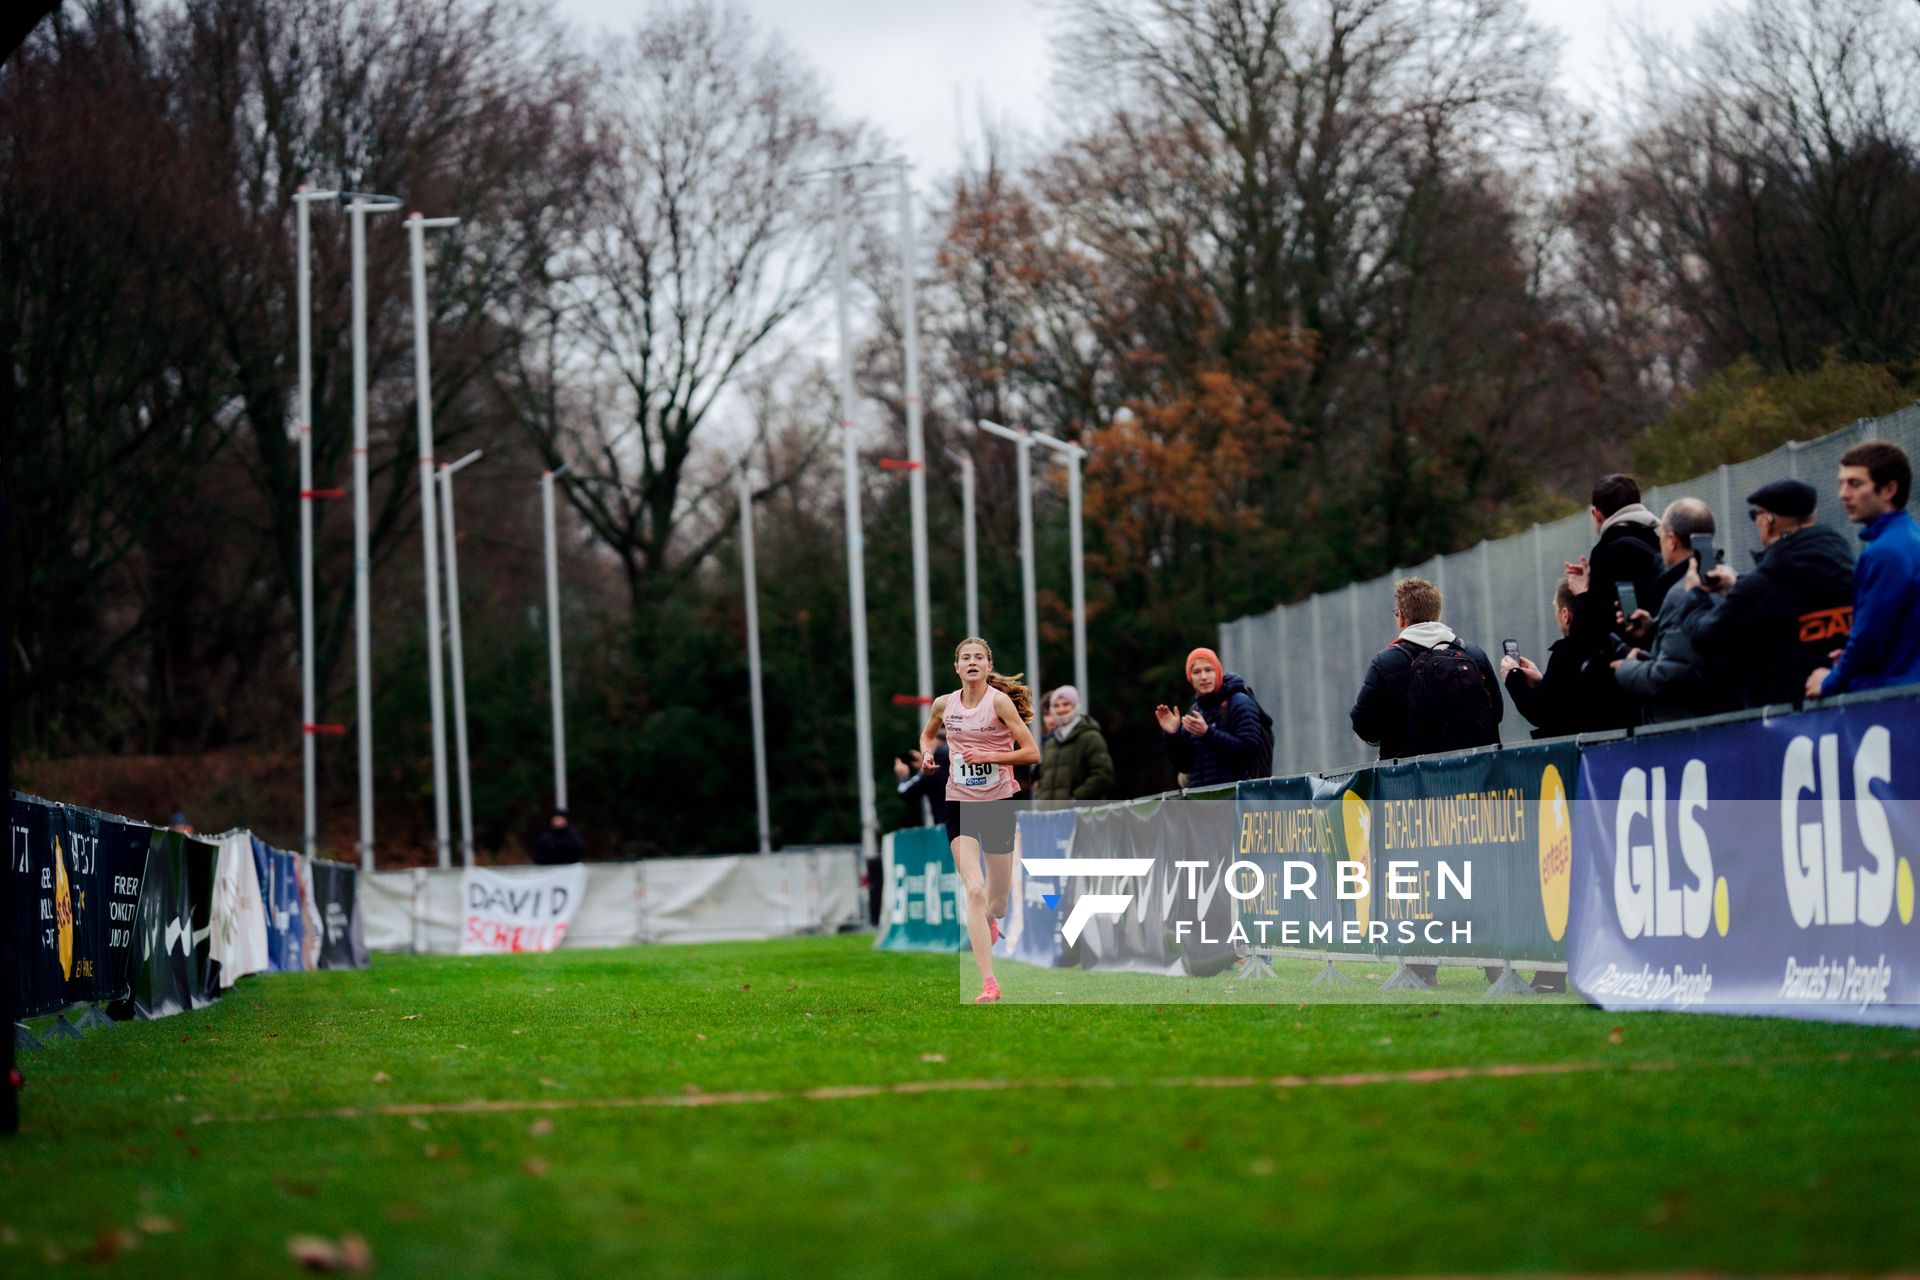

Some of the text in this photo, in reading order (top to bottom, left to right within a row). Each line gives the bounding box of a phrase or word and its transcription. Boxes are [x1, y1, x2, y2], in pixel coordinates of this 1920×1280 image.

[960, 762, 993, 777] 1150
[1384, 787, 1525, 850] EINFACH KLIMAFREUNDLICH
[468, 882, 569, 917] DAVID
